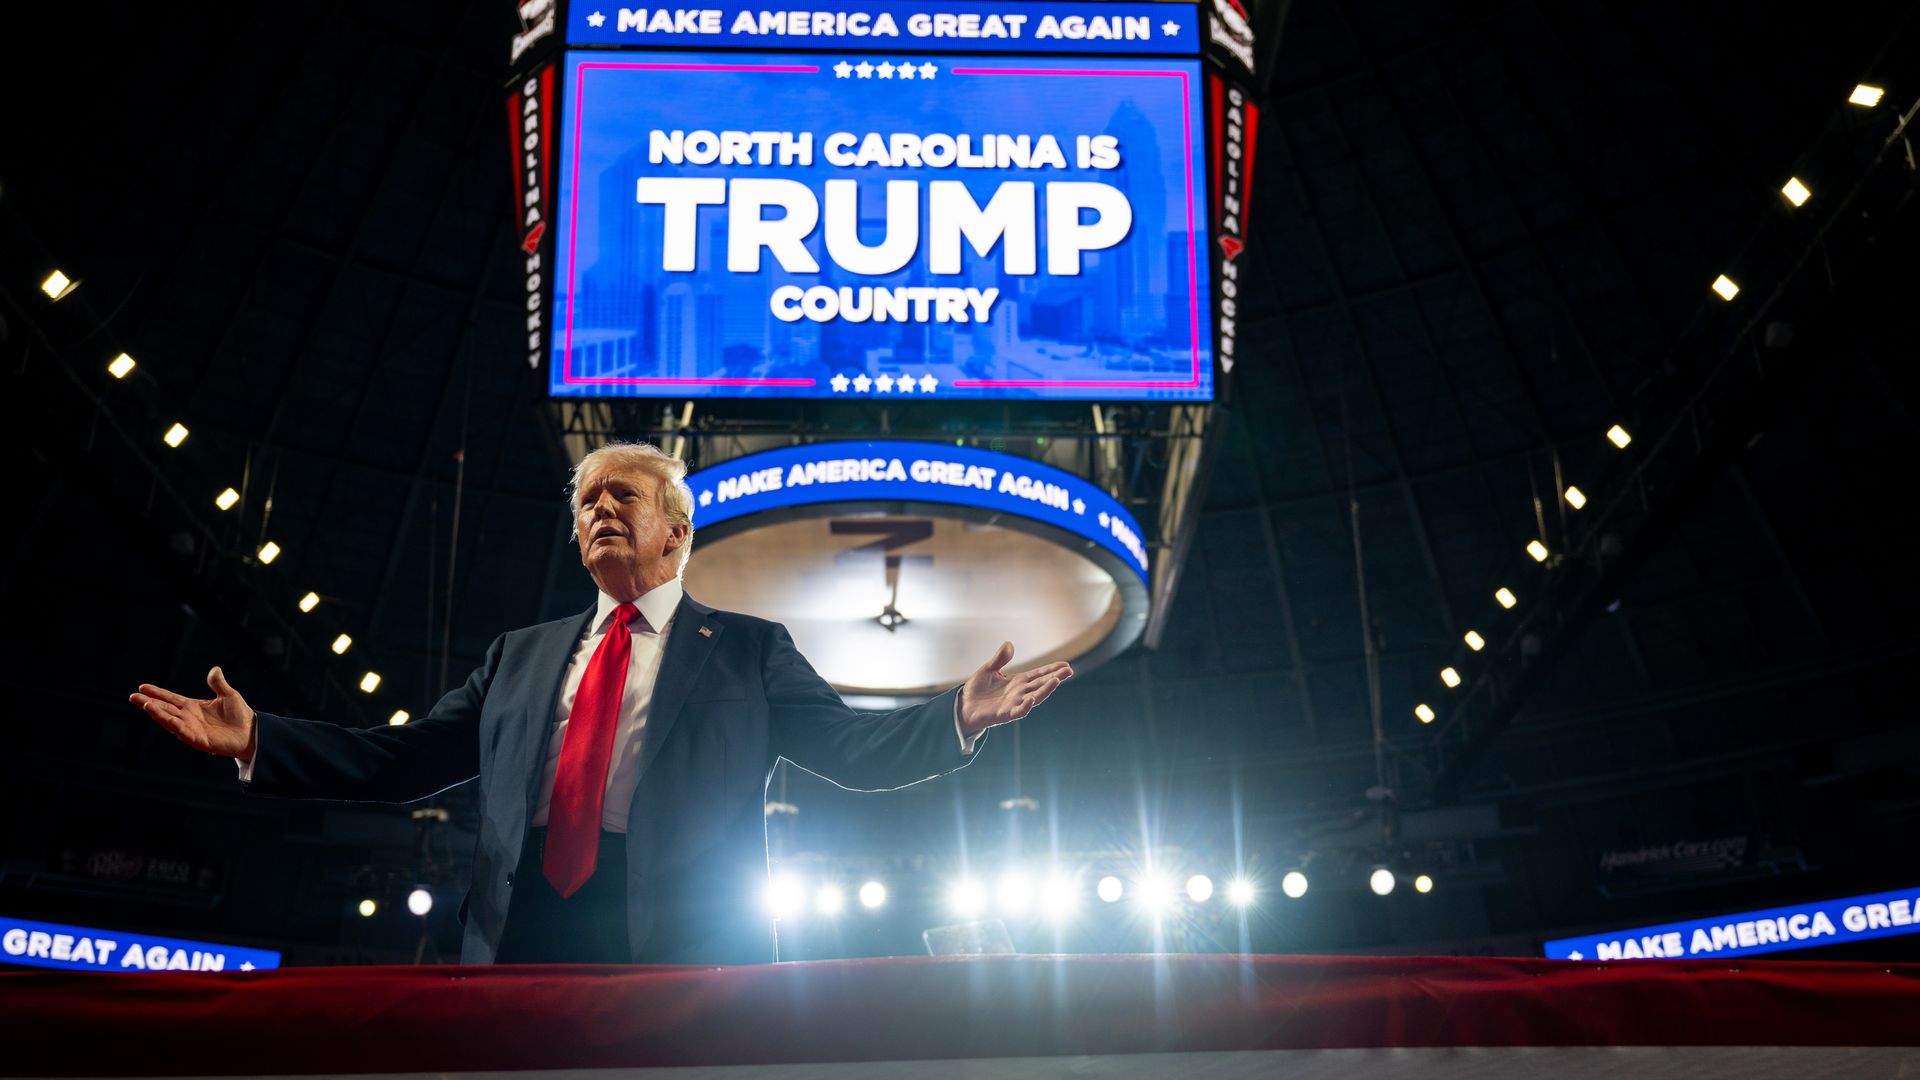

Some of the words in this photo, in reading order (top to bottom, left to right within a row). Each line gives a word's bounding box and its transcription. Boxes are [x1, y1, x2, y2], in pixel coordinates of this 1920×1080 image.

[618, 8, 722, 34] MAKE
[731, 10, 899, 37] AMERICA
[907, 13, 1028, 39] GREAT
[1035, 15, 1151, 41] AGAIN
[523, 77, 541, 227] CAROLINA
[648, 130, 813, 166] NORTH
[823, 132, 1067, 169] CAROLINA
[1076, 135, 1121, 170] IS
[1223, 88, 1243, 235] CAROLINA
[636, 176, 1133, 276] TRUMP
[526, 252, 541, 369] HOCKEY
[769, 285, 1000, 323] COUNTRY
[1220, 259, 1237, 374] HOCKEY
[717, 467, 784, 503] MAKE
[786, 458, 908, 488] AMERICA
[909, 459, 997, 491] GREAT
[998, 471, 1070, 511] AGAIN
[2, 928, 117, 965] GREAT
[121, 943, 225, 972] AGAIN
[1596, 932, 1685, 961] MAKE
[1690, 911, 1836, 954] AMERICA
